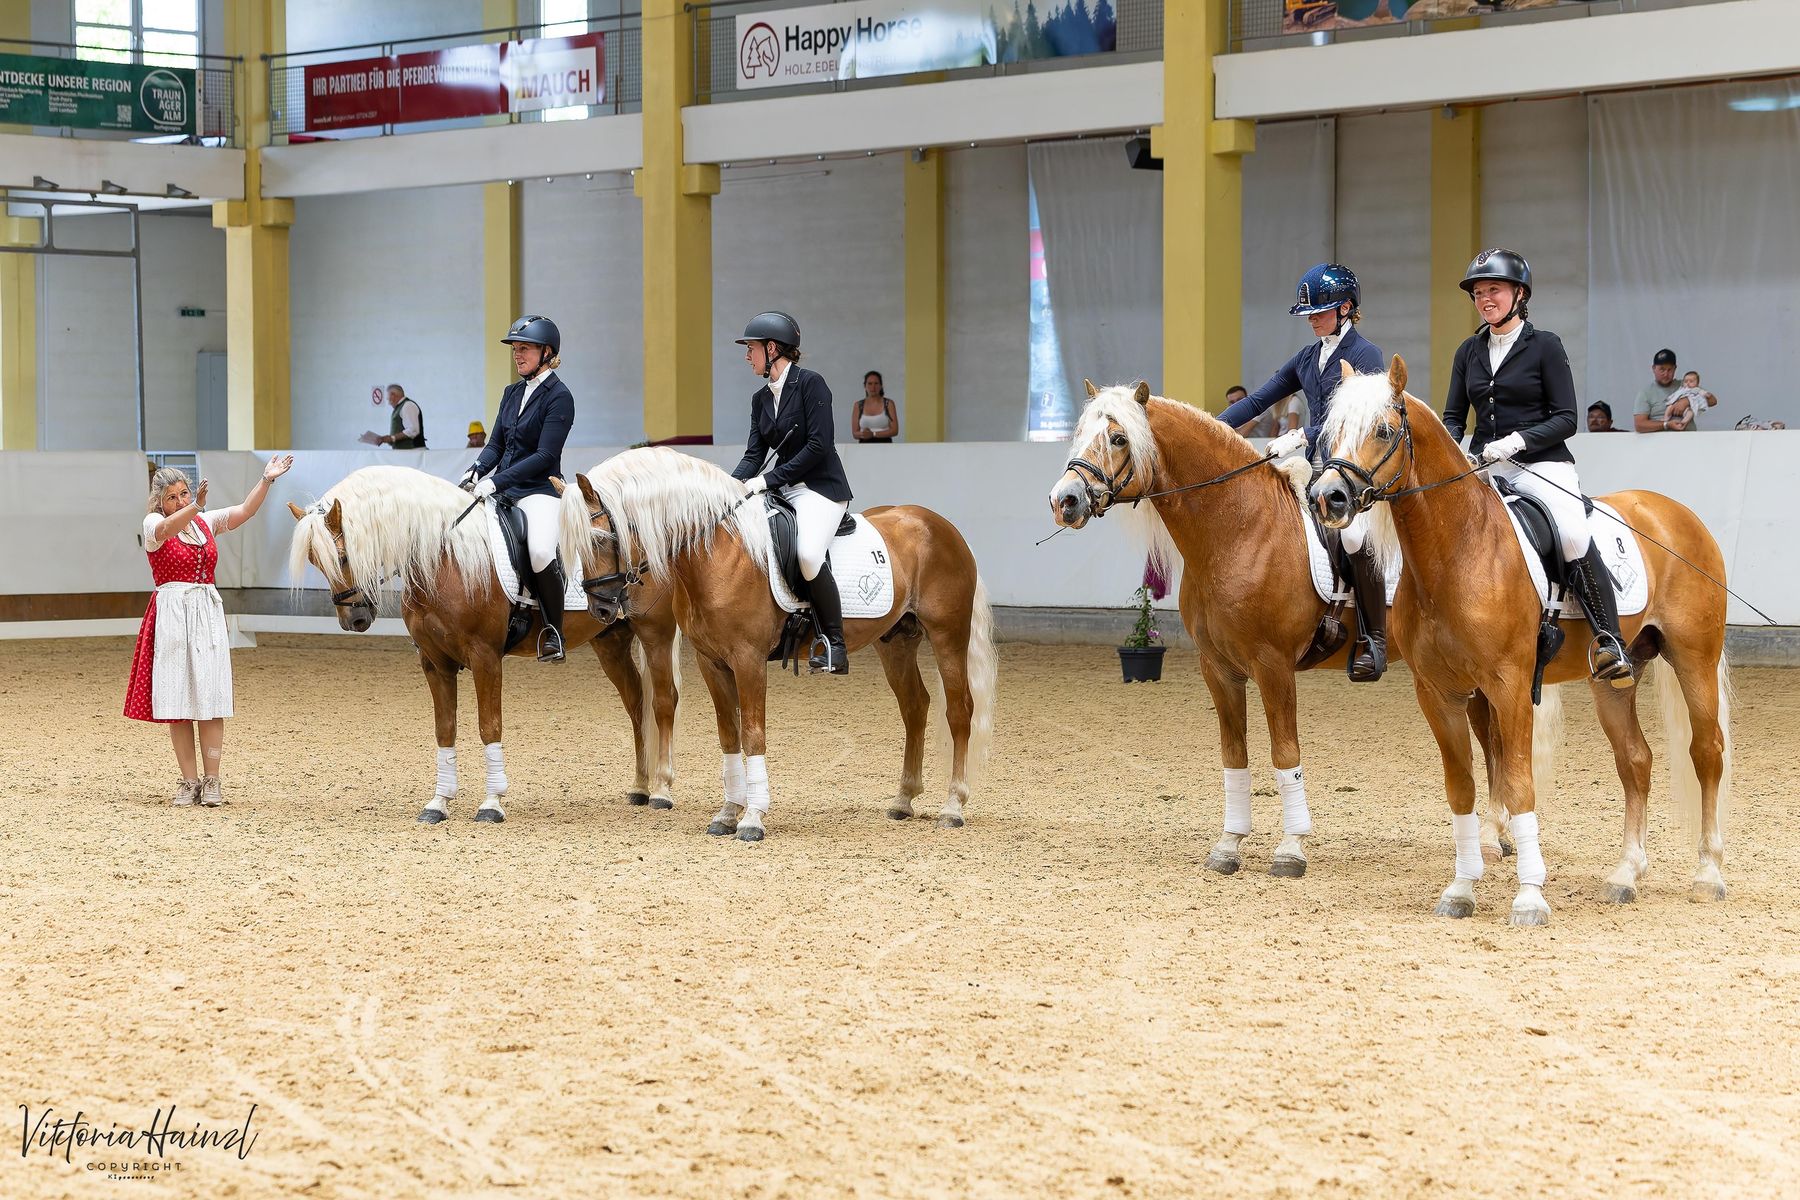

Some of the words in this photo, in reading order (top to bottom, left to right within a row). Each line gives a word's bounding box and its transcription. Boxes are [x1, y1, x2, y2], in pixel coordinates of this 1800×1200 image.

[785, 24, 852, 56] Happy
[857, 16, 922, 43] Horse
[48, 74, 90, 90] UNSERE
[92, 77, 132, 93] REGION
[312, 77, 327, 96] IHR
[329, 72, 367, 95] PARTNER
[369, 67, 384, 90] FÜR
[386, 68, 400, 88] DIE
[521, 68, 590, 99] MAUCH
[152, 88, 182, 100] TRAUN
[159, 100, 182, 111] AGER
[163, 110, 182, 121] ALM
[1616, 537, 1625, 554] 8
[871, 550, 886, 565] 15
